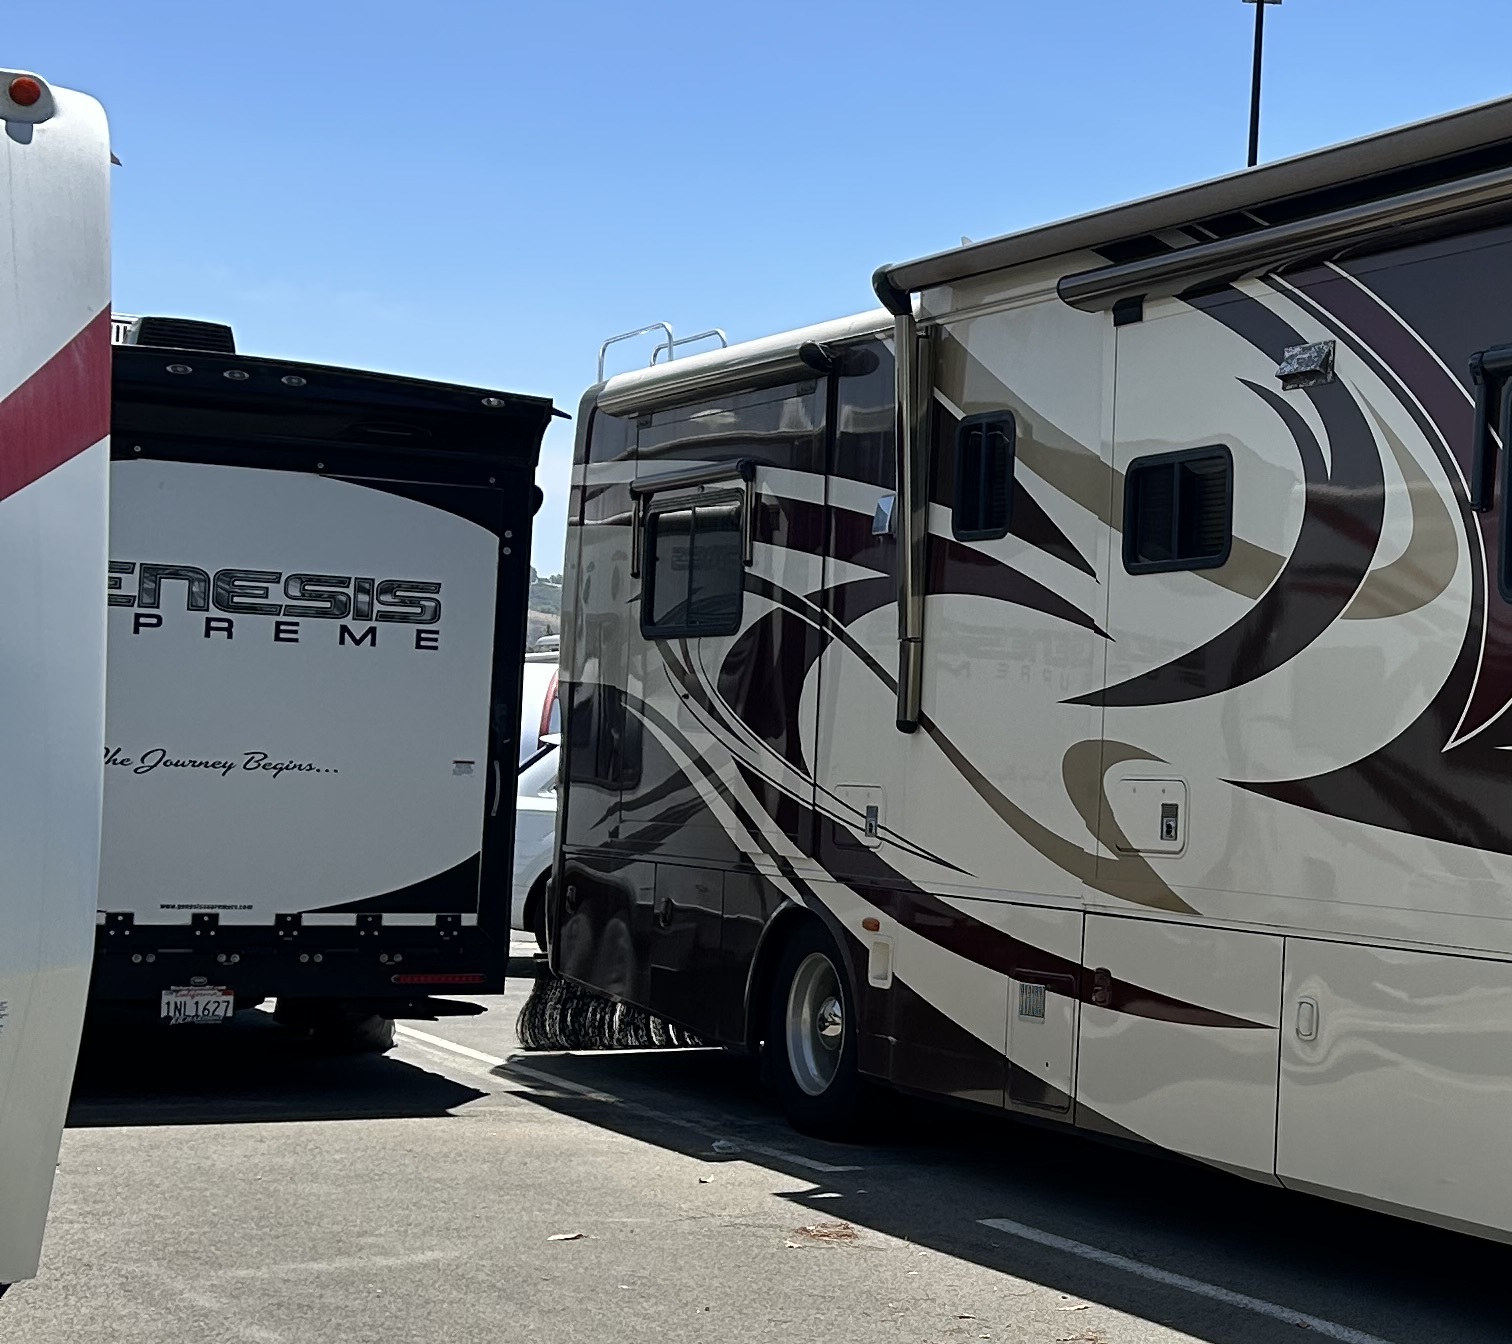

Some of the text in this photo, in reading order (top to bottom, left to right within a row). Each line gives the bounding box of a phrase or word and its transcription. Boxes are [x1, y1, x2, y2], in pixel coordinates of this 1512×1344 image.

[108, 560, 442, 625] NESIS
[133, 612, 440, 651] PREME
[133, 748, 236, 776] Journey
[243, 751, 339, 779] Begins...
[165, 1000, 231, 1017] 1NL1627
